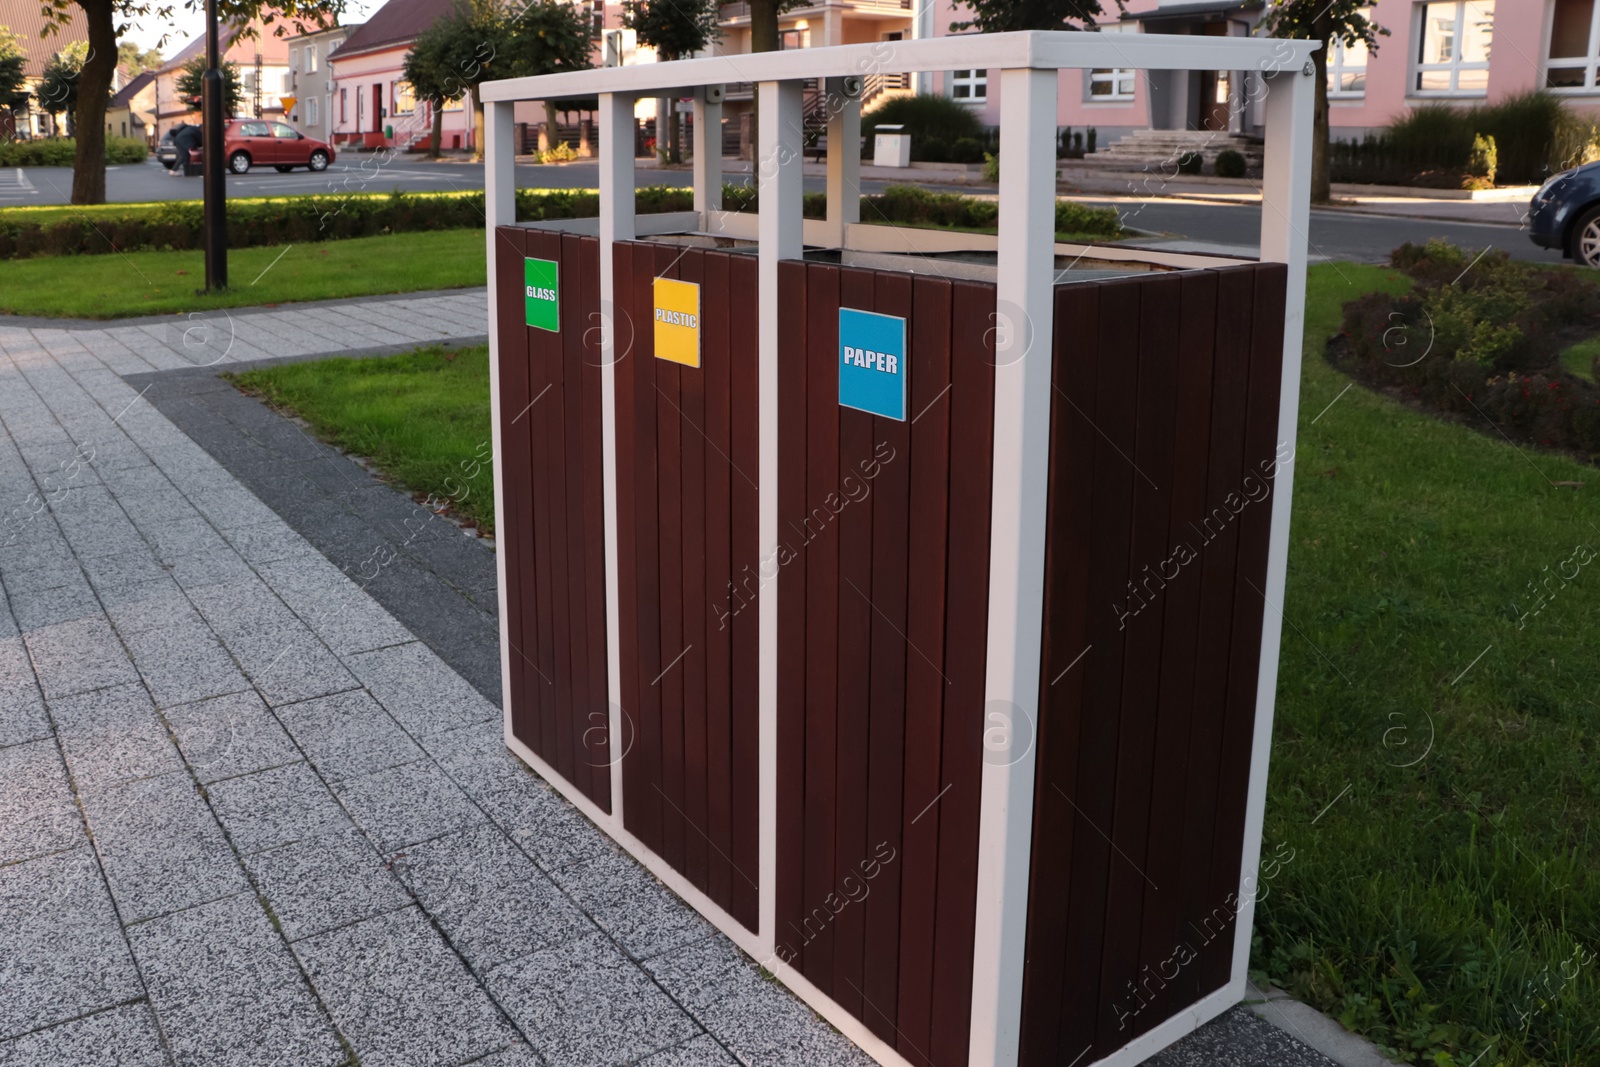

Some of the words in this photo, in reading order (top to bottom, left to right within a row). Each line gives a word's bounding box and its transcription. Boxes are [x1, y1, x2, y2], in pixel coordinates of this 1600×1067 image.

[526, 285, 556, 302] GLASS
[655, 308, 697, 329] PLASTIC
[843, 346, 898, 375] PAPER
